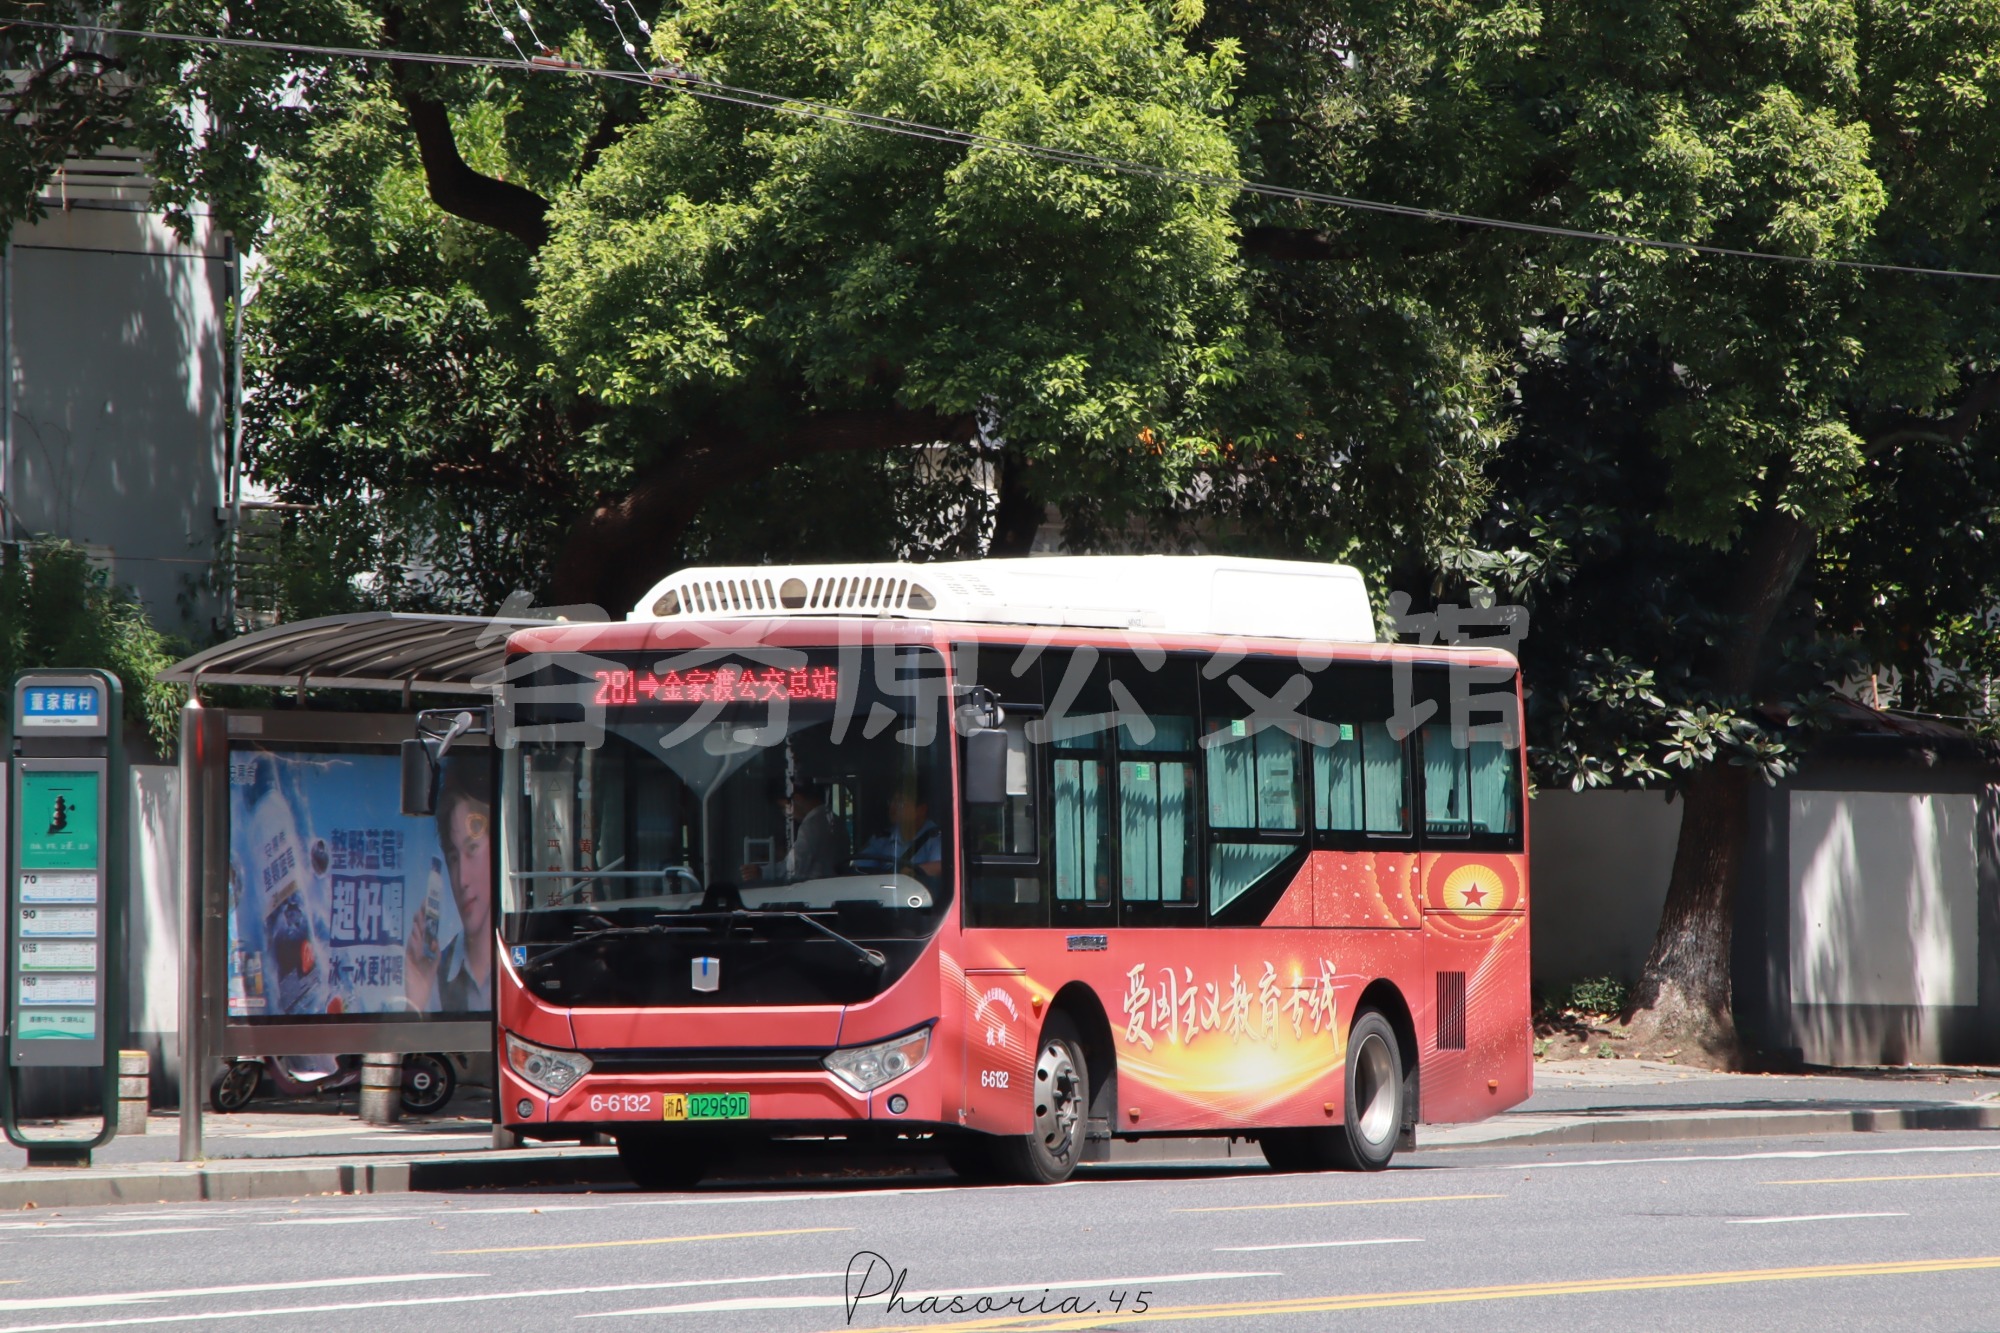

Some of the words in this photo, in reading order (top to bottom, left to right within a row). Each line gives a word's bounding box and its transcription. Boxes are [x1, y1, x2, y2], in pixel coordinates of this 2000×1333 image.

[595, 670, 638, 704] 281
[661, 666, 838, 703] 金家渡公交总站
[30, 692, 92, 711] 董家新村
[23, 875, 37, 884] 70
[22, 910, 36, 919] 90
[331, 880, 403, 941] 超好喝
[328, 954, 403, 987] 冰一冰更好喝
[22, 977, 36, 987] 160
[1124, 957, 1350, 1055] 爱国主义教育专线
[986, 1024, 1007, 1048] 杭州
[981, 1069, 1009, 1089] 6-6132
[589, 1094, 651, 1112] 6-6132
